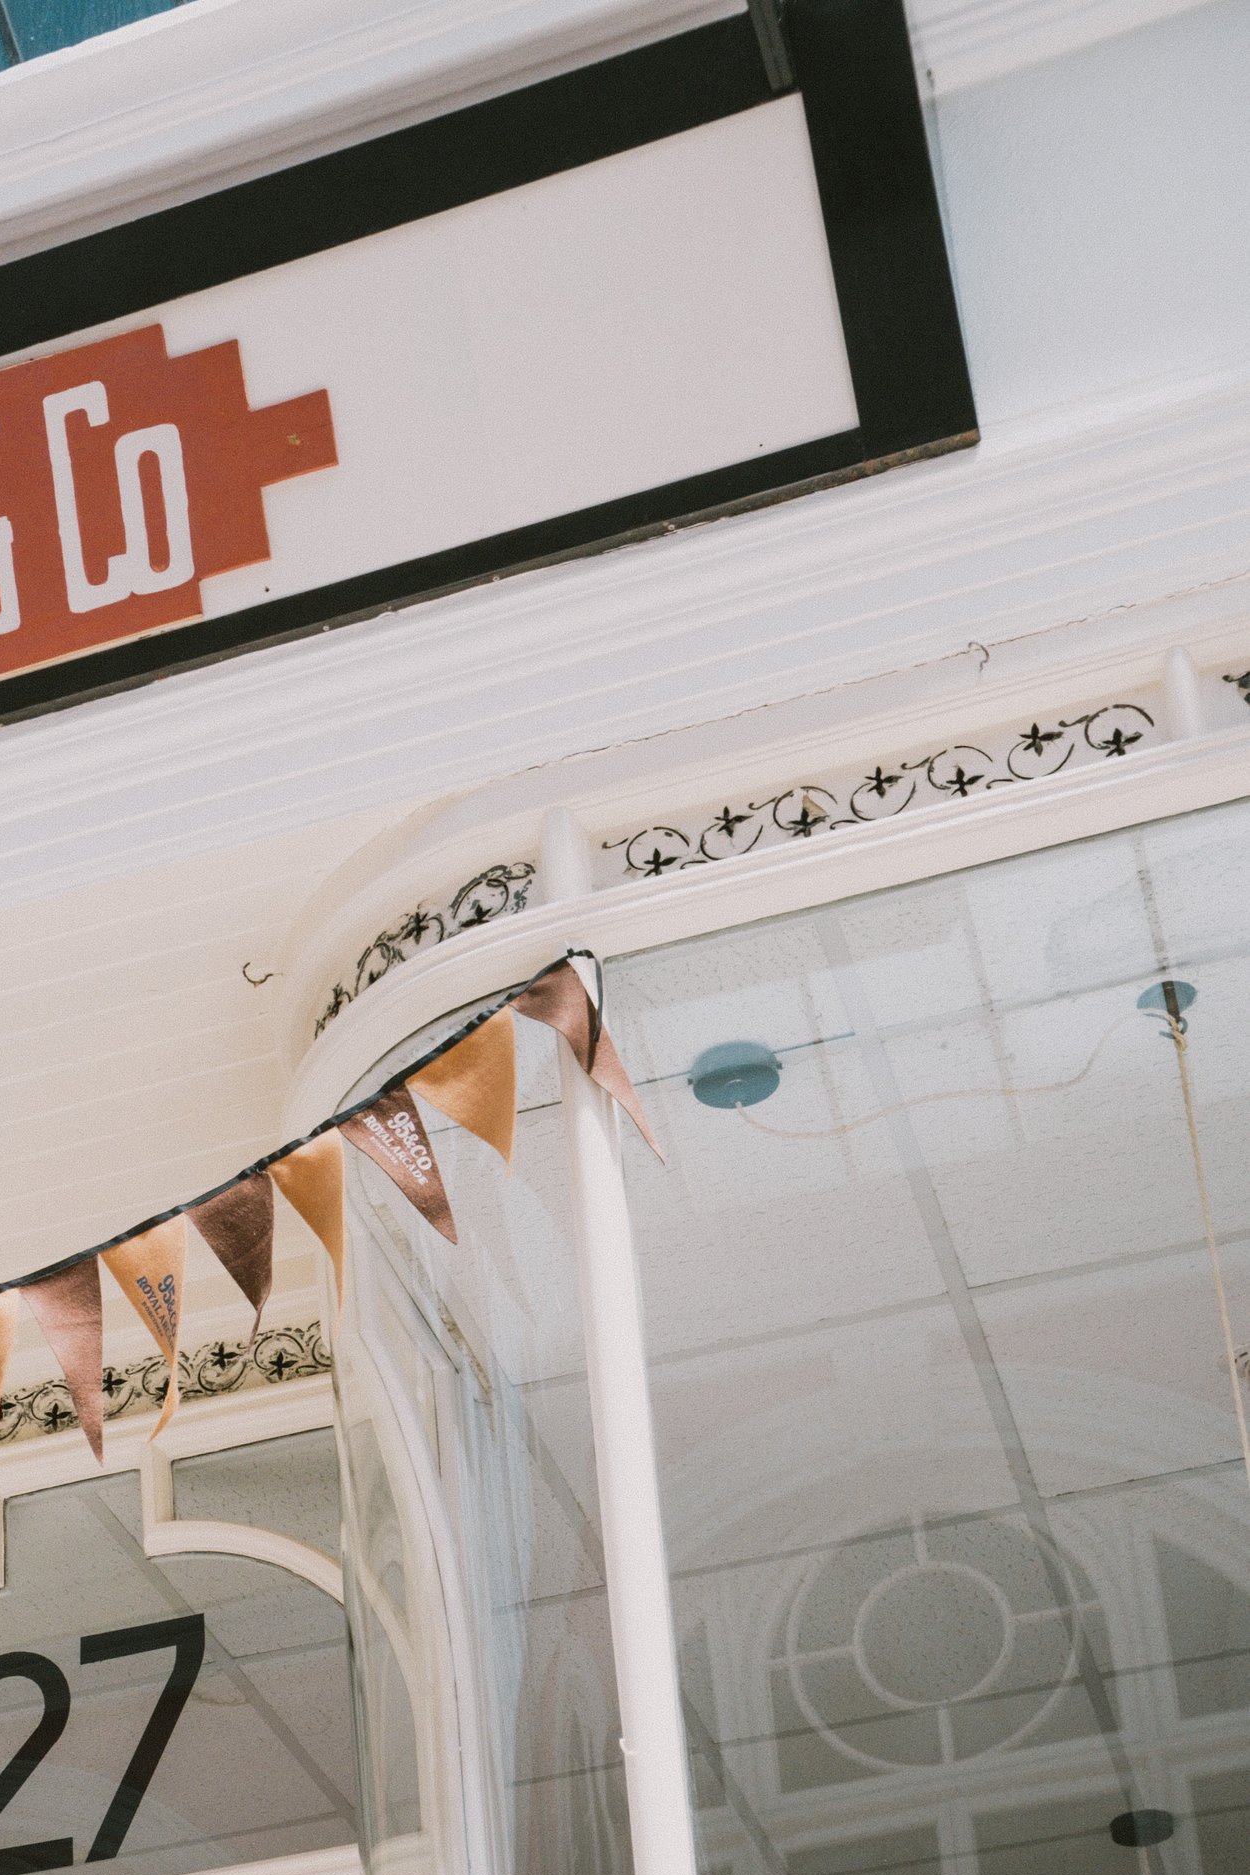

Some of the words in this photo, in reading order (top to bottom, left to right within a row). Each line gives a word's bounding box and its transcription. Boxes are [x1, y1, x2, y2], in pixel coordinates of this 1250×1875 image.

[363, 1115, 395, 1147] ROYAL
[390, 1146, 429, 1185] ARCADE
[387, 1111, 432, 1171] 95&CO
[136, 1276, 162, 1315] ROYAL
